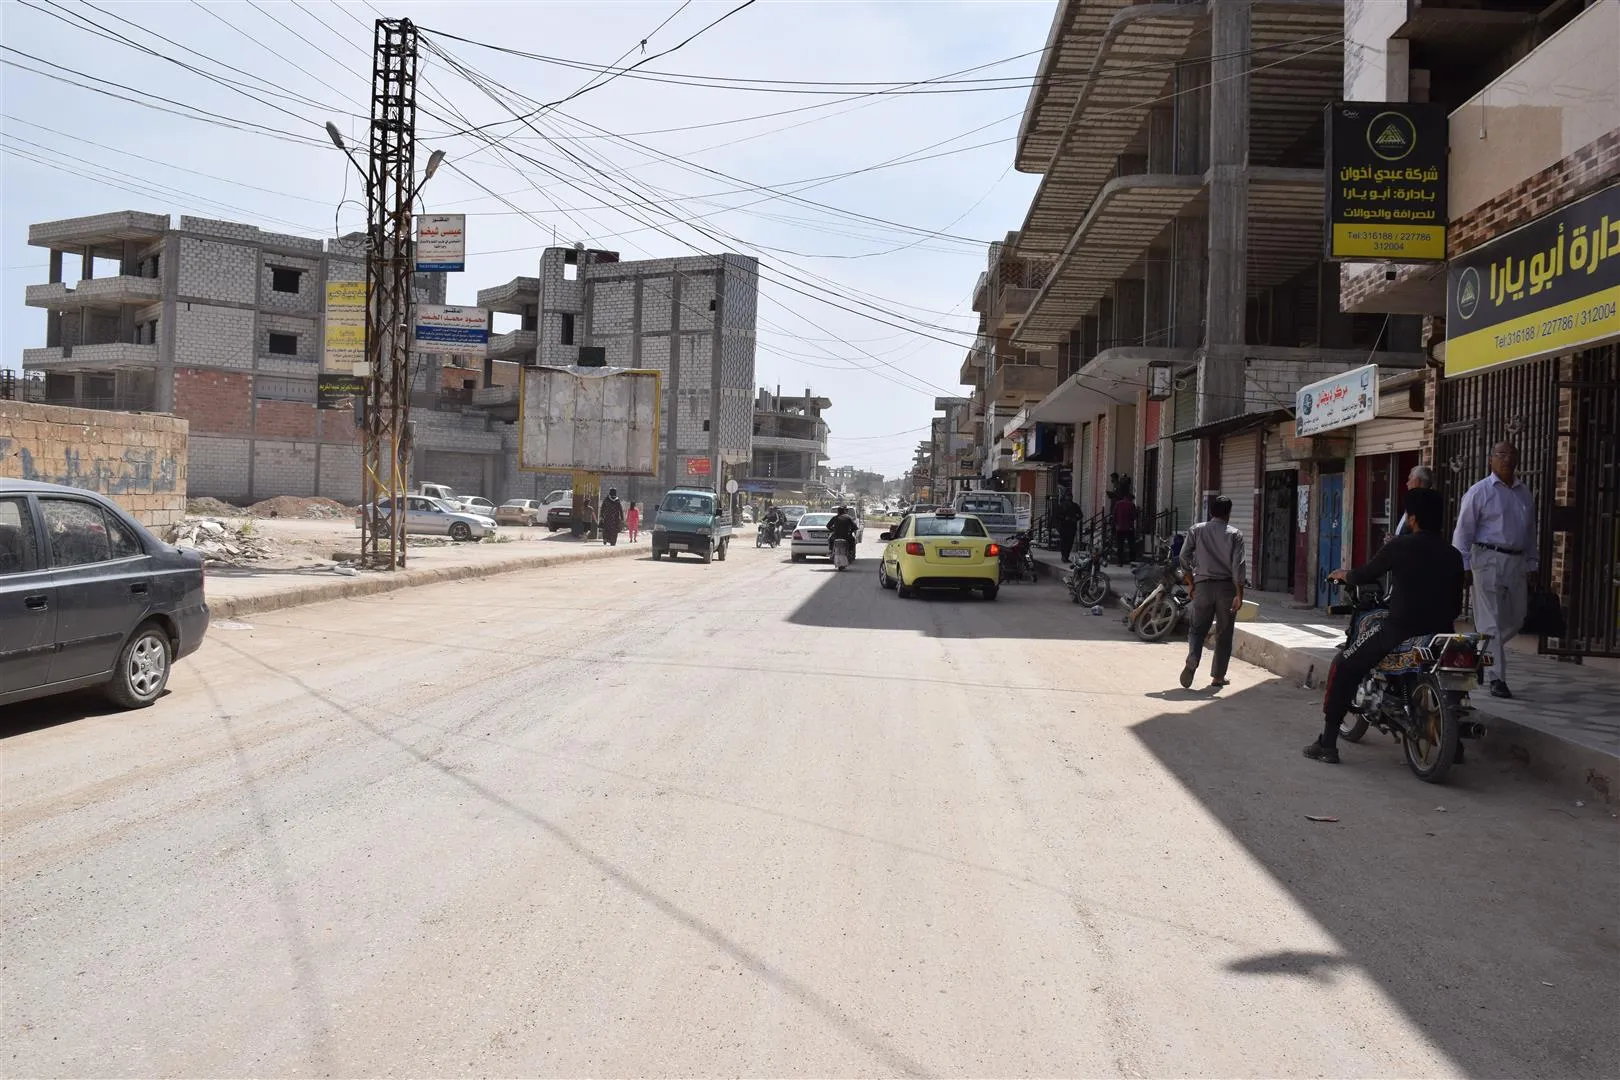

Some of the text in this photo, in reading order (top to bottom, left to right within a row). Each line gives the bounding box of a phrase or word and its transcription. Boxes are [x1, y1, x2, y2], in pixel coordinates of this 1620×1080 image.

[1374, 169, 1404, 183] عبدي
[1405, 165, 1438, 182] شركة
[1343, 187, 1367, 200] يارا
[1343, 208, 1435, 220] للصرافة والحوالات
[1400, 233, 1431, 241] 227786
[1530, 222, 1564, 296] أبو
[1490, 256, 1525, 307] يارا
[1541, 315, 1573, 337] 227786
[1581, 301, 1616, 326] 312004
